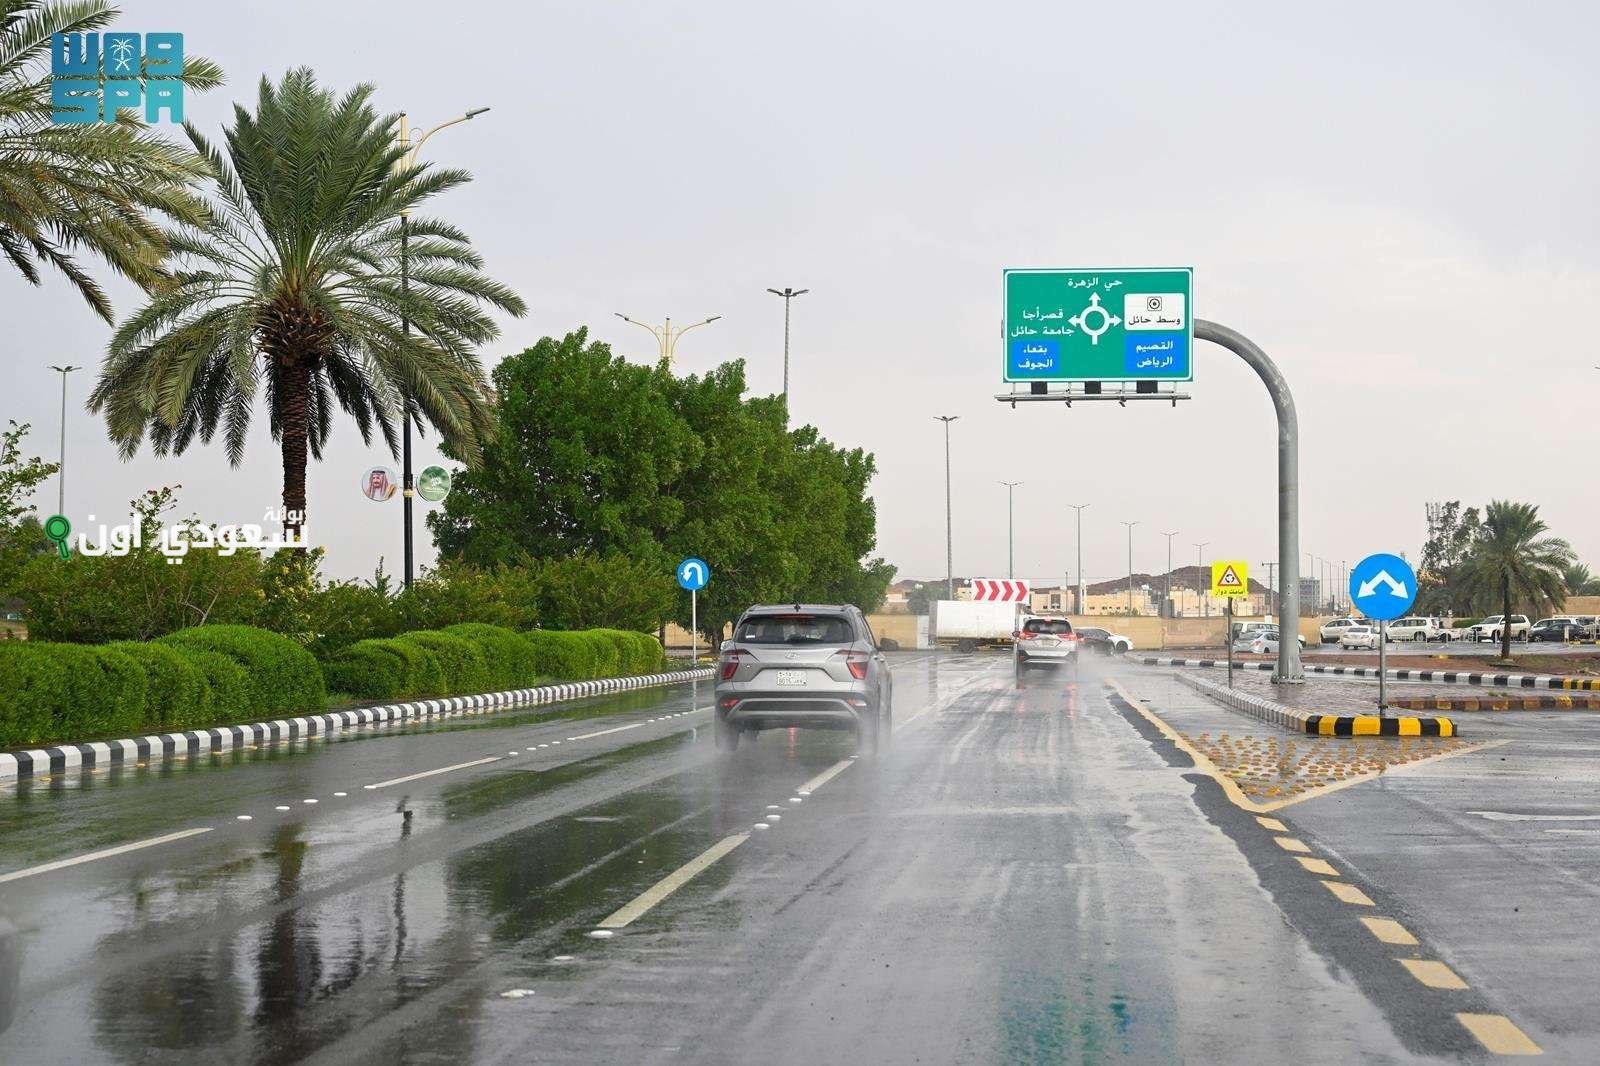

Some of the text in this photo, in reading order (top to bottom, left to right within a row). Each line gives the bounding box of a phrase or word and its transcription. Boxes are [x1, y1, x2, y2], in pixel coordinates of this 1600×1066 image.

[1067, 277, 1123, 291] حي الزهرة
[1128, 315, 1181, 325] وسط حائل
[1011, 326, 1075, 337] جامعة حائل
[1023, 344, 1048, 355] بقعاء
[1135, 340, 1174, 353] القصيم
[1018, 358, 1053, 370] الجوف
[1136, 356, 1173, 368] الرياض
